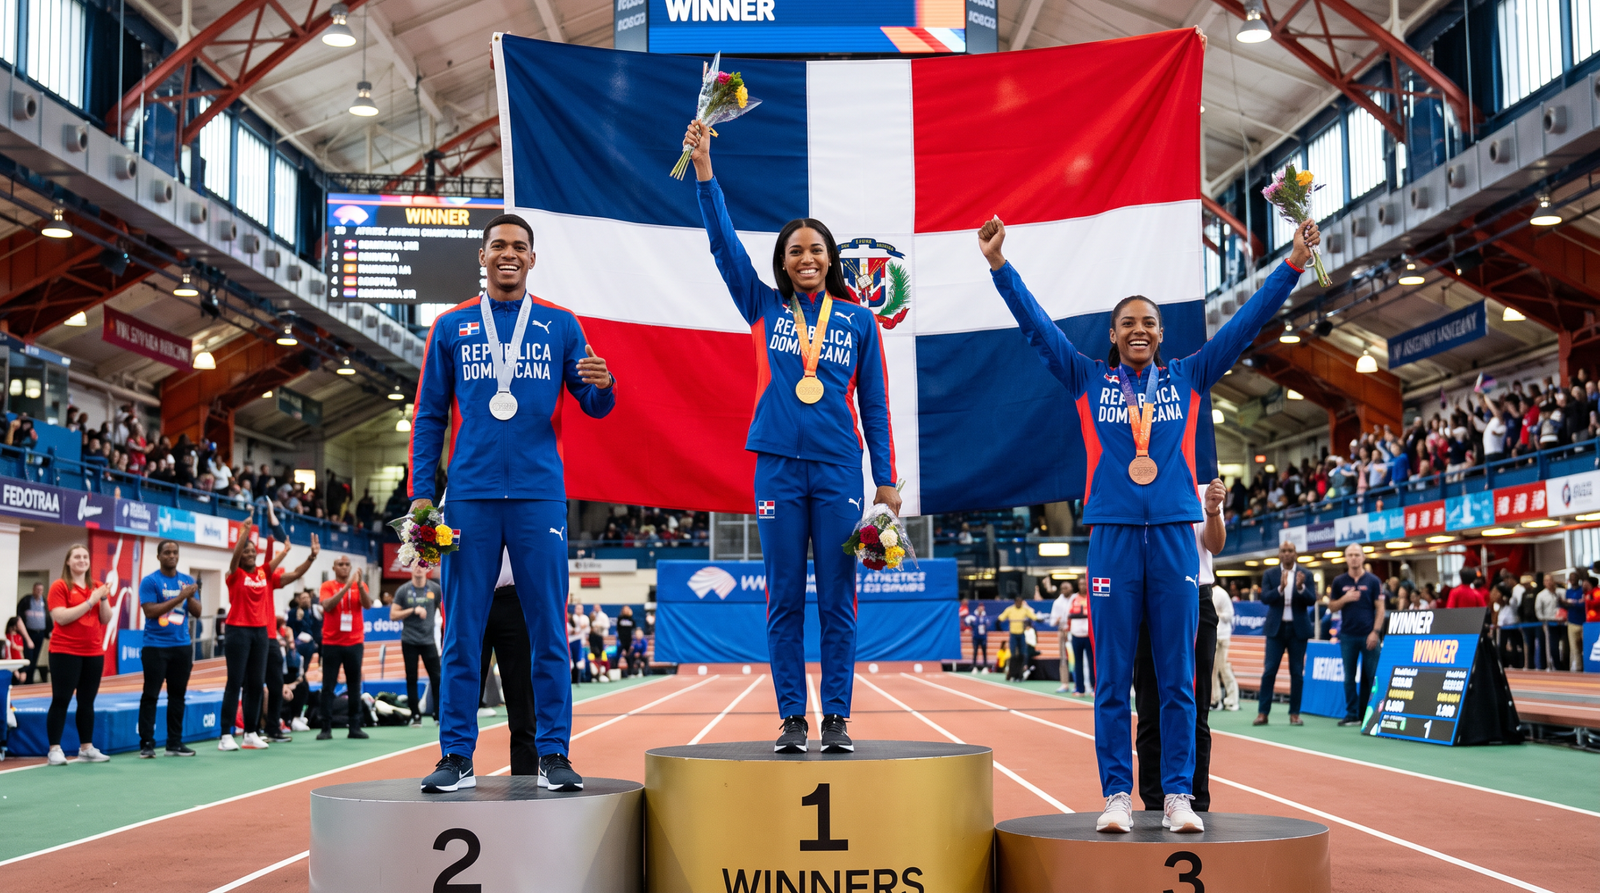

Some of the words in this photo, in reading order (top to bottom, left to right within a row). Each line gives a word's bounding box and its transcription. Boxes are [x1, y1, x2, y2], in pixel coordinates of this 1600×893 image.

[665, 0, 776, 22] WINNER
[405, 208, 470, 226] WINNER
[332, 239, 338, 249] 1
[773, 317, 853, 349] REPBLICA
[769, 334, 852, 367] DOMICANA
[462, 362, 551, 381] DOMICANA
[1099, 385, 1181, 409] REPBICA
[1098, 403, 1184, 424] DOMCANA
[3, 484, 60, 513] FEDOTRAA
[1388, 611, 1434, 634] WINNER
[1412, 639, 1459, 664] WINNER
[1423, 719, 1433, 739] 1
[800, 783, 848, 851] 1
[432, 828, 482, 893] 2
[1163, 850, 1205, 893] 3
[722, 866, 925, 893] WINNERS
